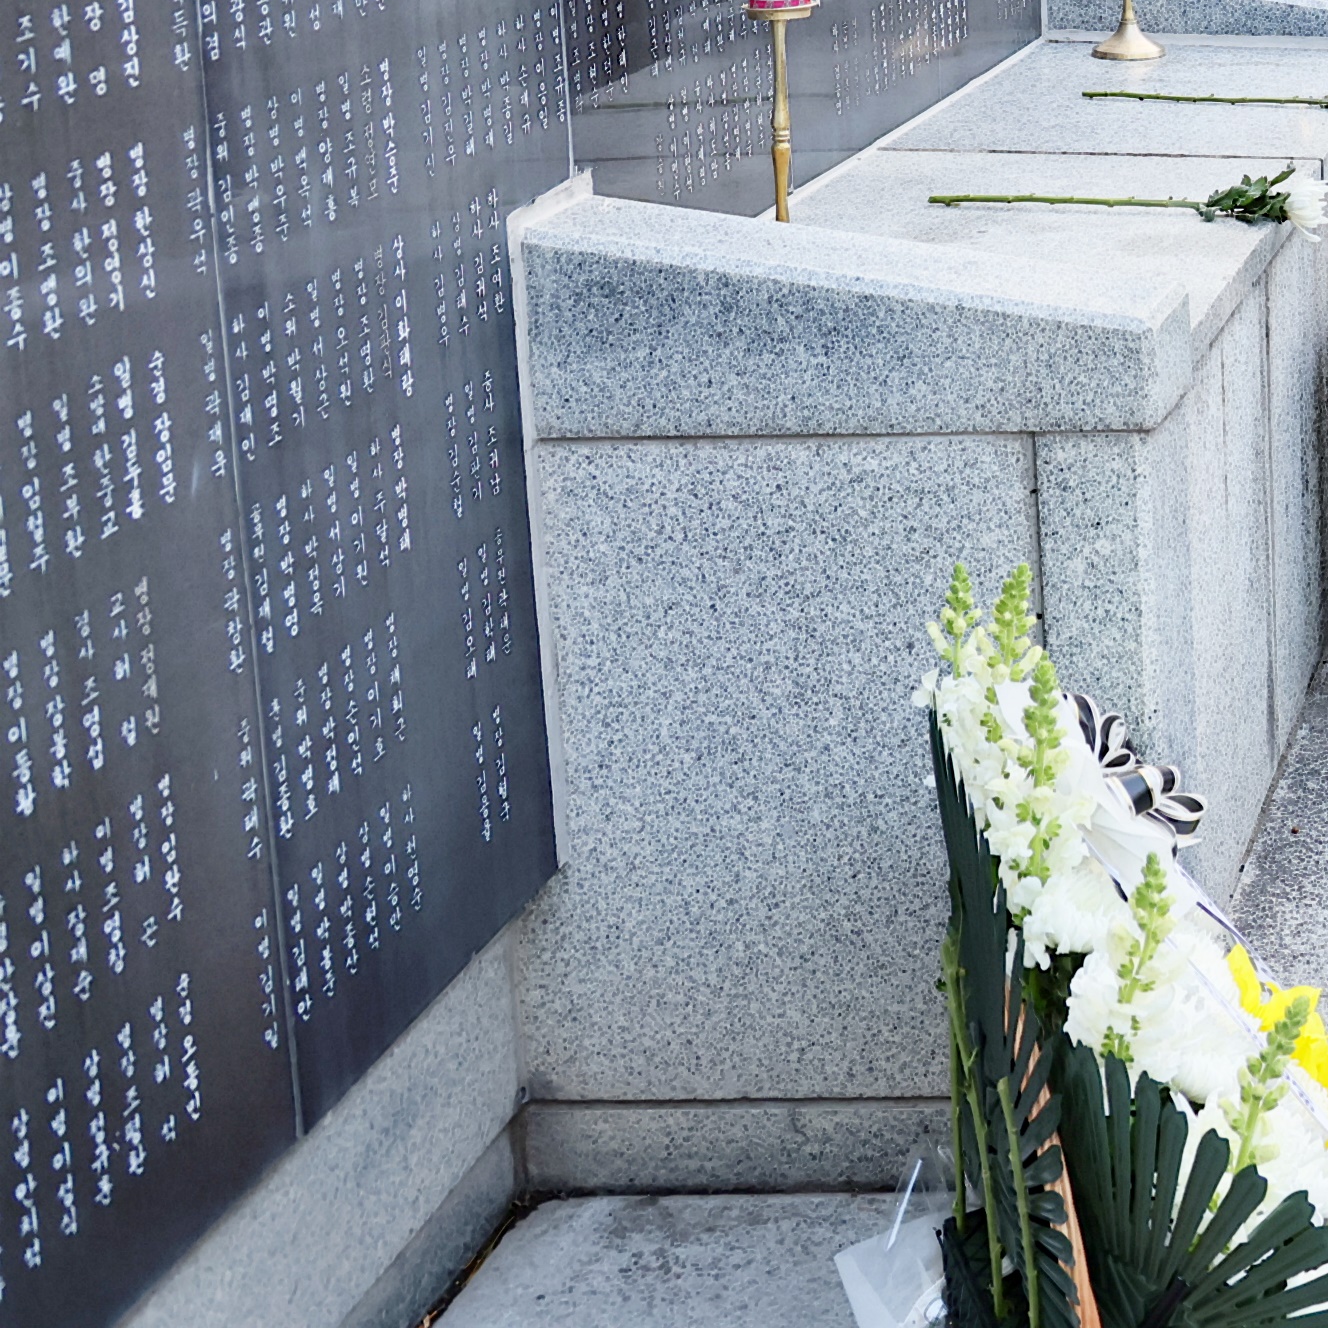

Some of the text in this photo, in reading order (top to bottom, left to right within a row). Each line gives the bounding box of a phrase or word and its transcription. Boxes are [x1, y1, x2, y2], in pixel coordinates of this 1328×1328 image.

[378, 57, 393, 107] 병장
[416, 45, 429, 92] 일병
[266, 95, 280, 147] 상병
[315, 80, 329, 130] 병장
[337, 71, 352, 121] 일병
[182, 124, 199, 180] 병장
[213, 111, 229, 162] 중위
[128, 141, 149, 198] 병장
[392, 234, 407, 282] 상사
[431, 220, 443, 262] 하사
[452, 211, 462, 257] 상병
[283, 292, 297, 337] 소위
[306, 278, 321, 329] 일병
[331, 267, 345, 317] 병장
[231, 312, 249, 361] 하사
[256, 301, 272, 353] 이병
[444, 392, 457, 438] 병장
[481, 369, 495, 413] 중사
[16, 409, 37, 470] 병장
[52, 393, 72, 453] 일병
[322, 464, 338, 514] 일병
[346, 450, 360, 499] 일병
[39, 629, 60, 689] 병장
[363, 627, 377, 675] 병장
[237, 718, 253, 768] 중위
[157, 773, 175, 827] 병장
[379, 801, 393, 849] 일병
[335, 841, 349, 890] 상병
[358, 821, 371, 869] 상병
[286, 883, 302, 934] 일병
